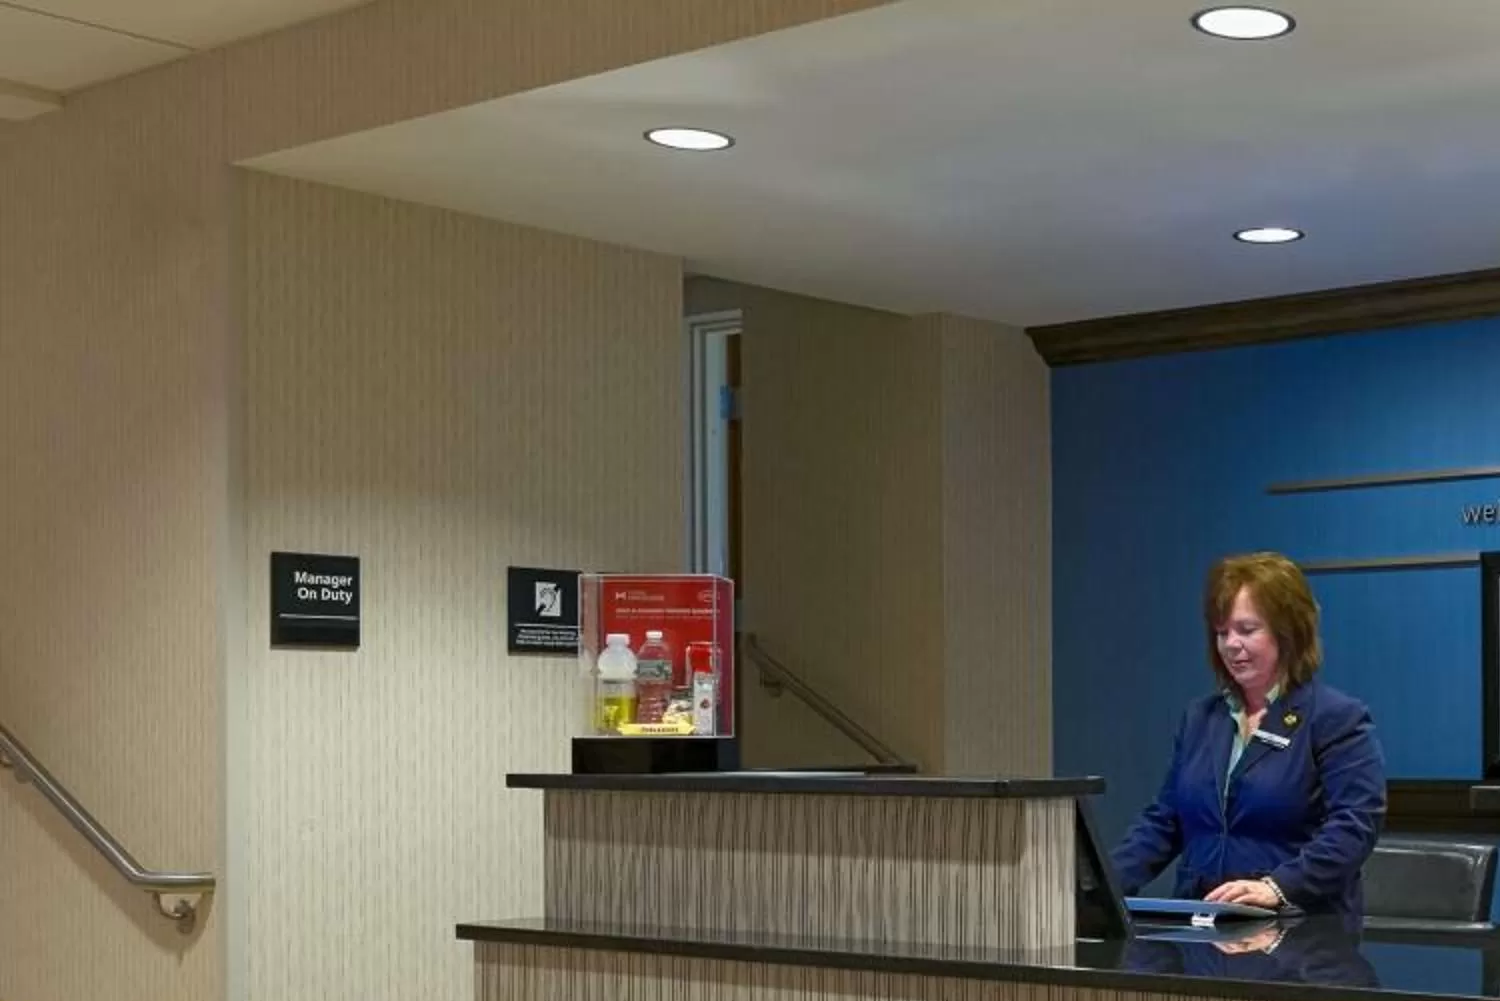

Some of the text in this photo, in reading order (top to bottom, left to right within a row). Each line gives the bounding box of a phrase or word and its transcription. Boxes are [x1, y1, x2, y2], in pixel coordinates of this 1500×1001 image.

[294, 571, 353, 588] Manager
[297, 587, 353, 605] On Duty
